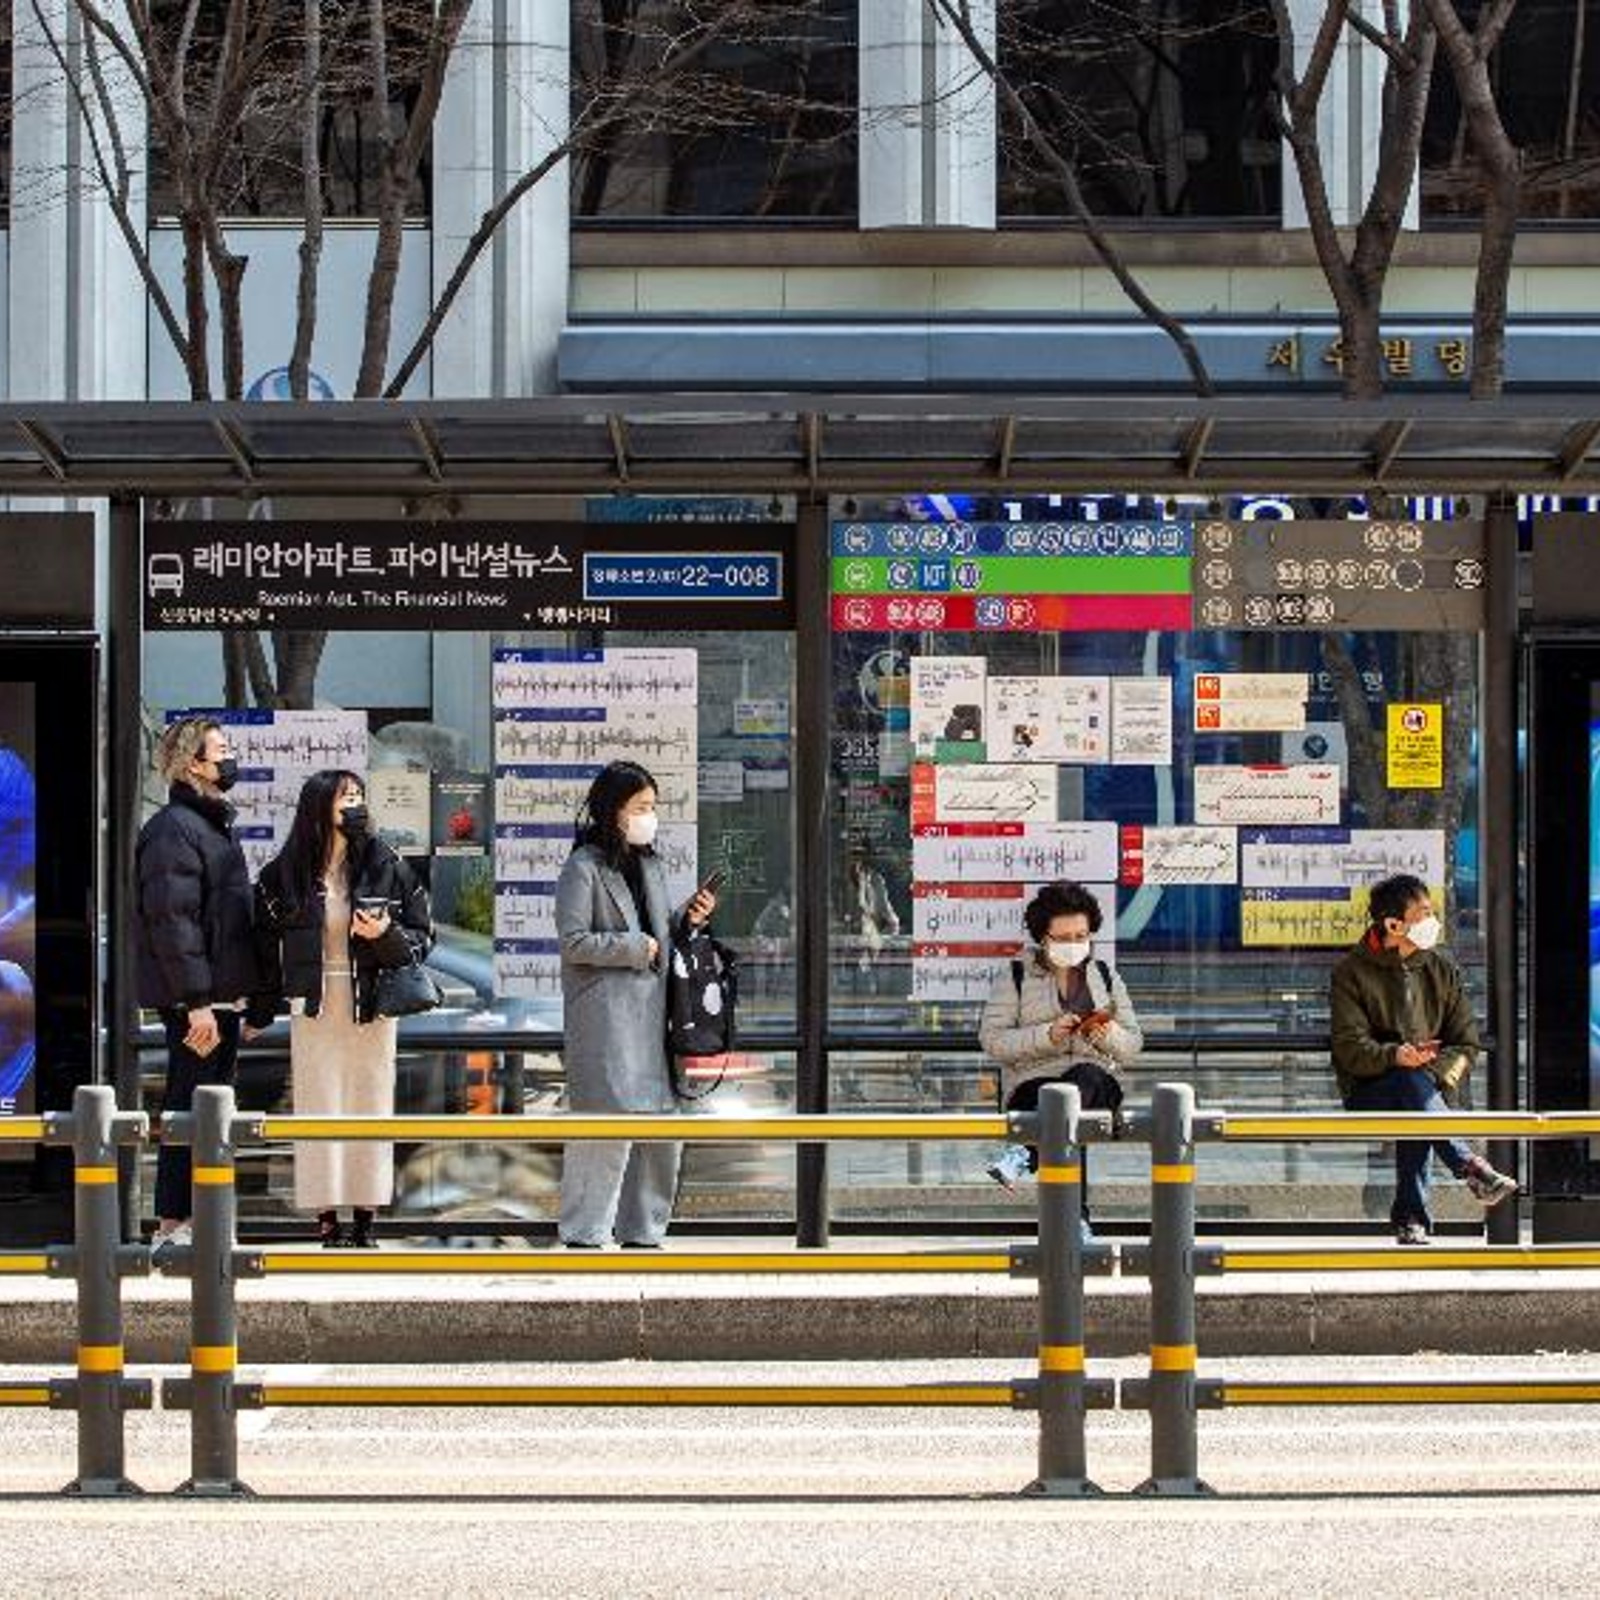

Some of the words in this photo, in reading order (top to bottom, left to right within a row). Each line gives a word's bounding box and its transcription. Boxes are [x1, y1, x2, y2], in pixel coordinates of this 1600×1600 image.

[193, 541, 573, 578] 래미안아파트.파이낸셜뉴스
[682, 565, 770, 586] 22-008
[361, 590, 391, 607] The
[395, 590, 463, 607] Financial
[466, 590, 508, 607] News
